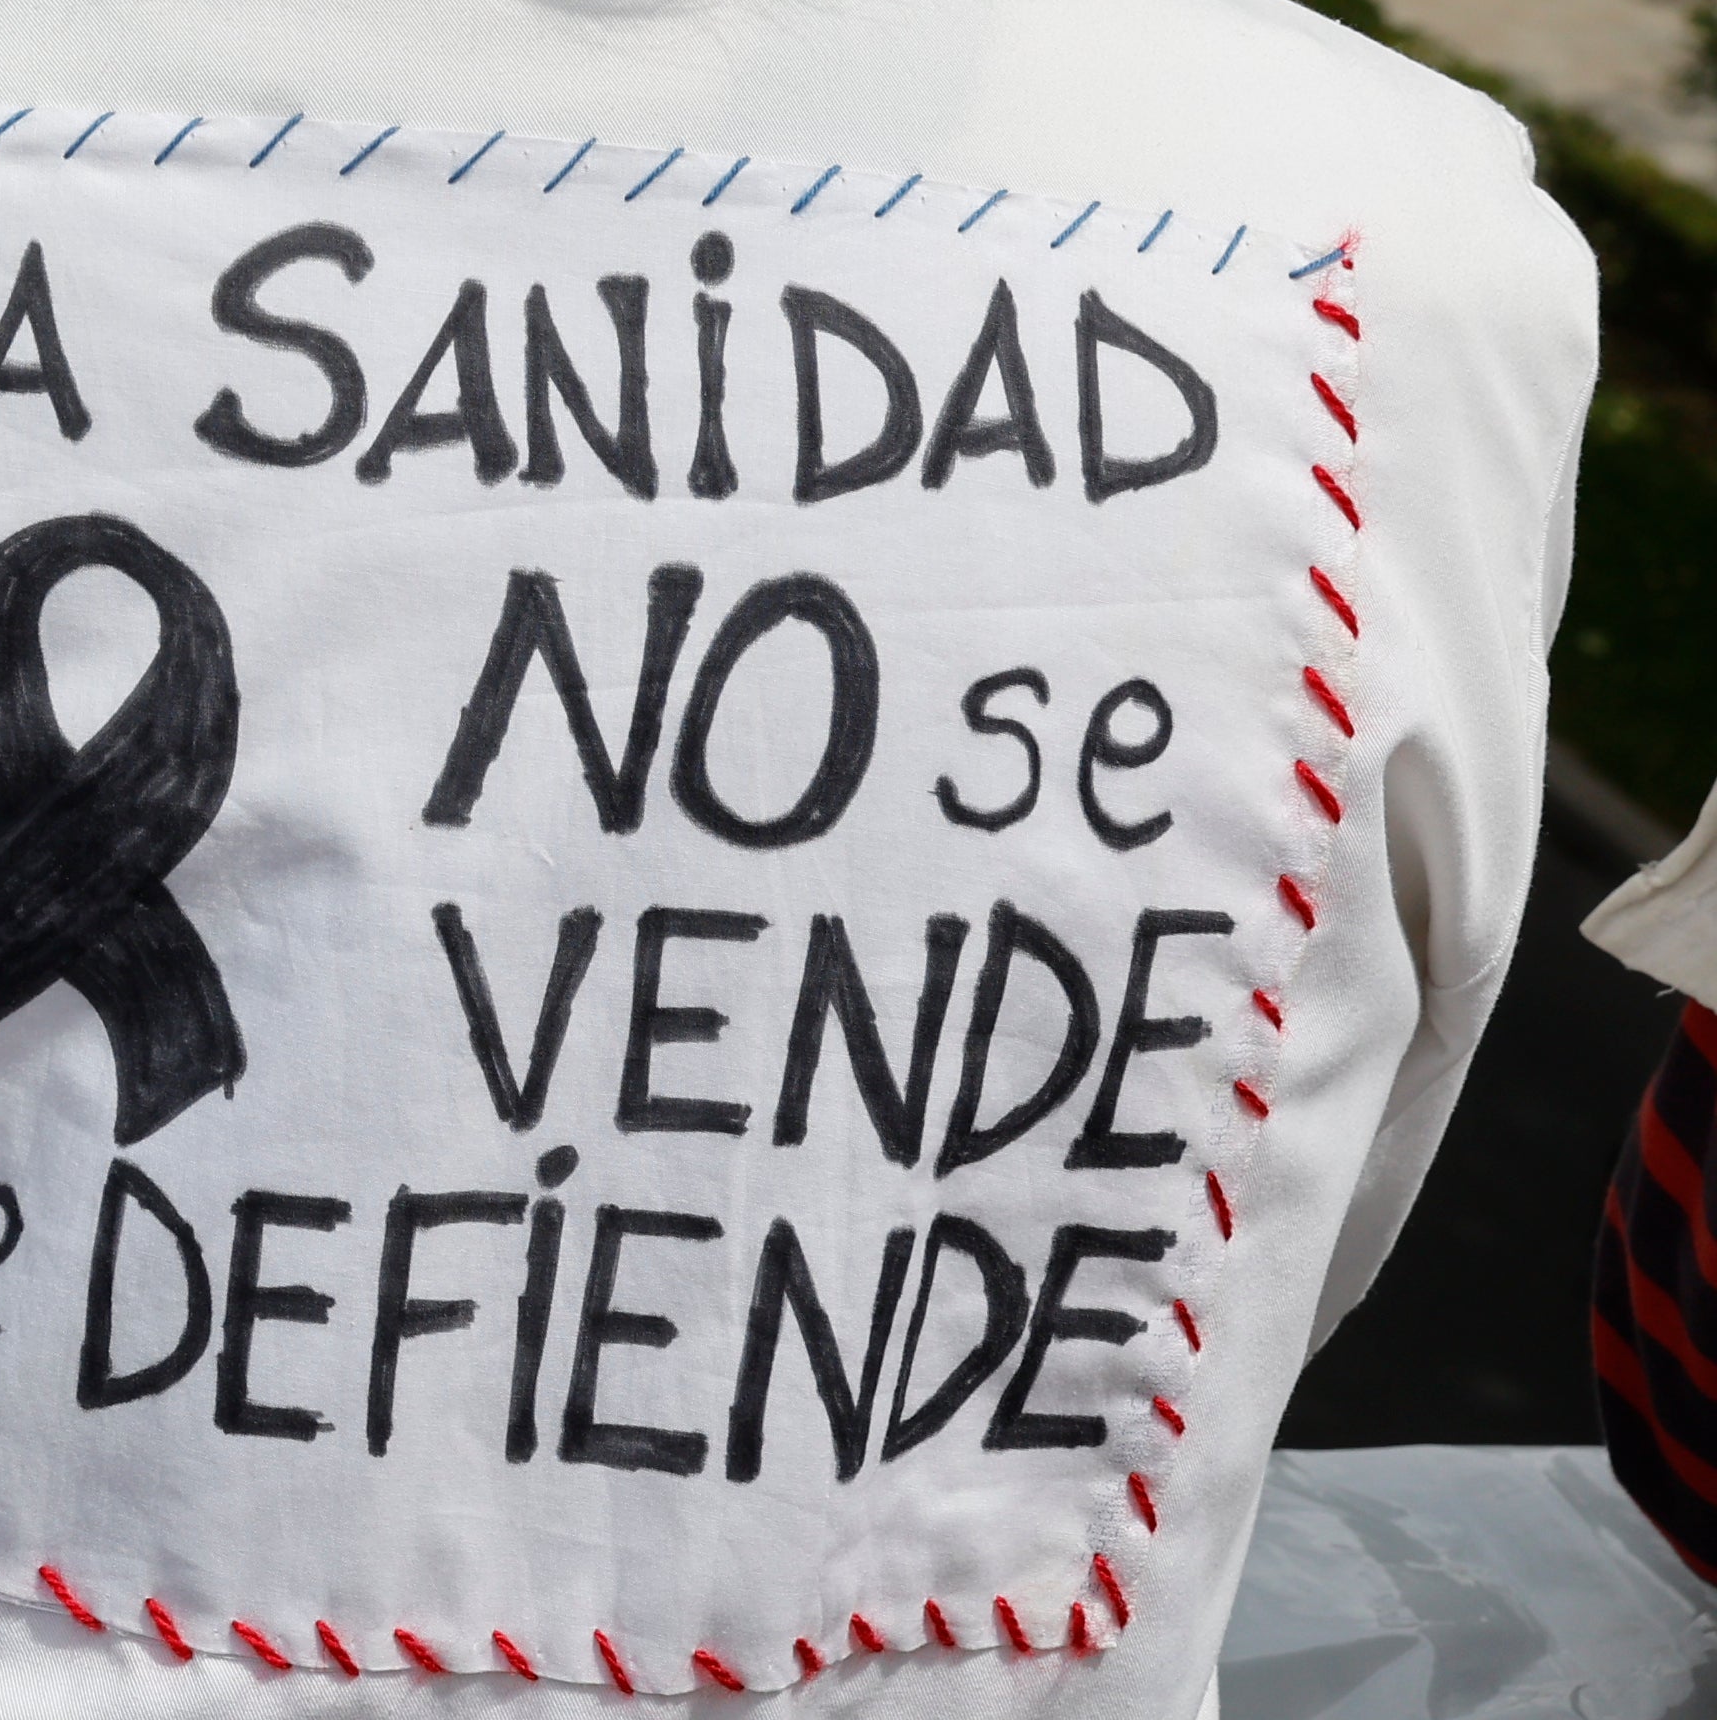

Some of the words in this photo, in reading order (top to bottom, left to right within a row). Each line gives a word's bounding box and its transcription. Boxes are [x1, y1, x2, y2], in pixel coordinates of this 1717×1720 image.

[422, 564, 880, 851] NO
[930, 667, 1174, 852] se
[431, 899, 1236, 1180] VENDE
